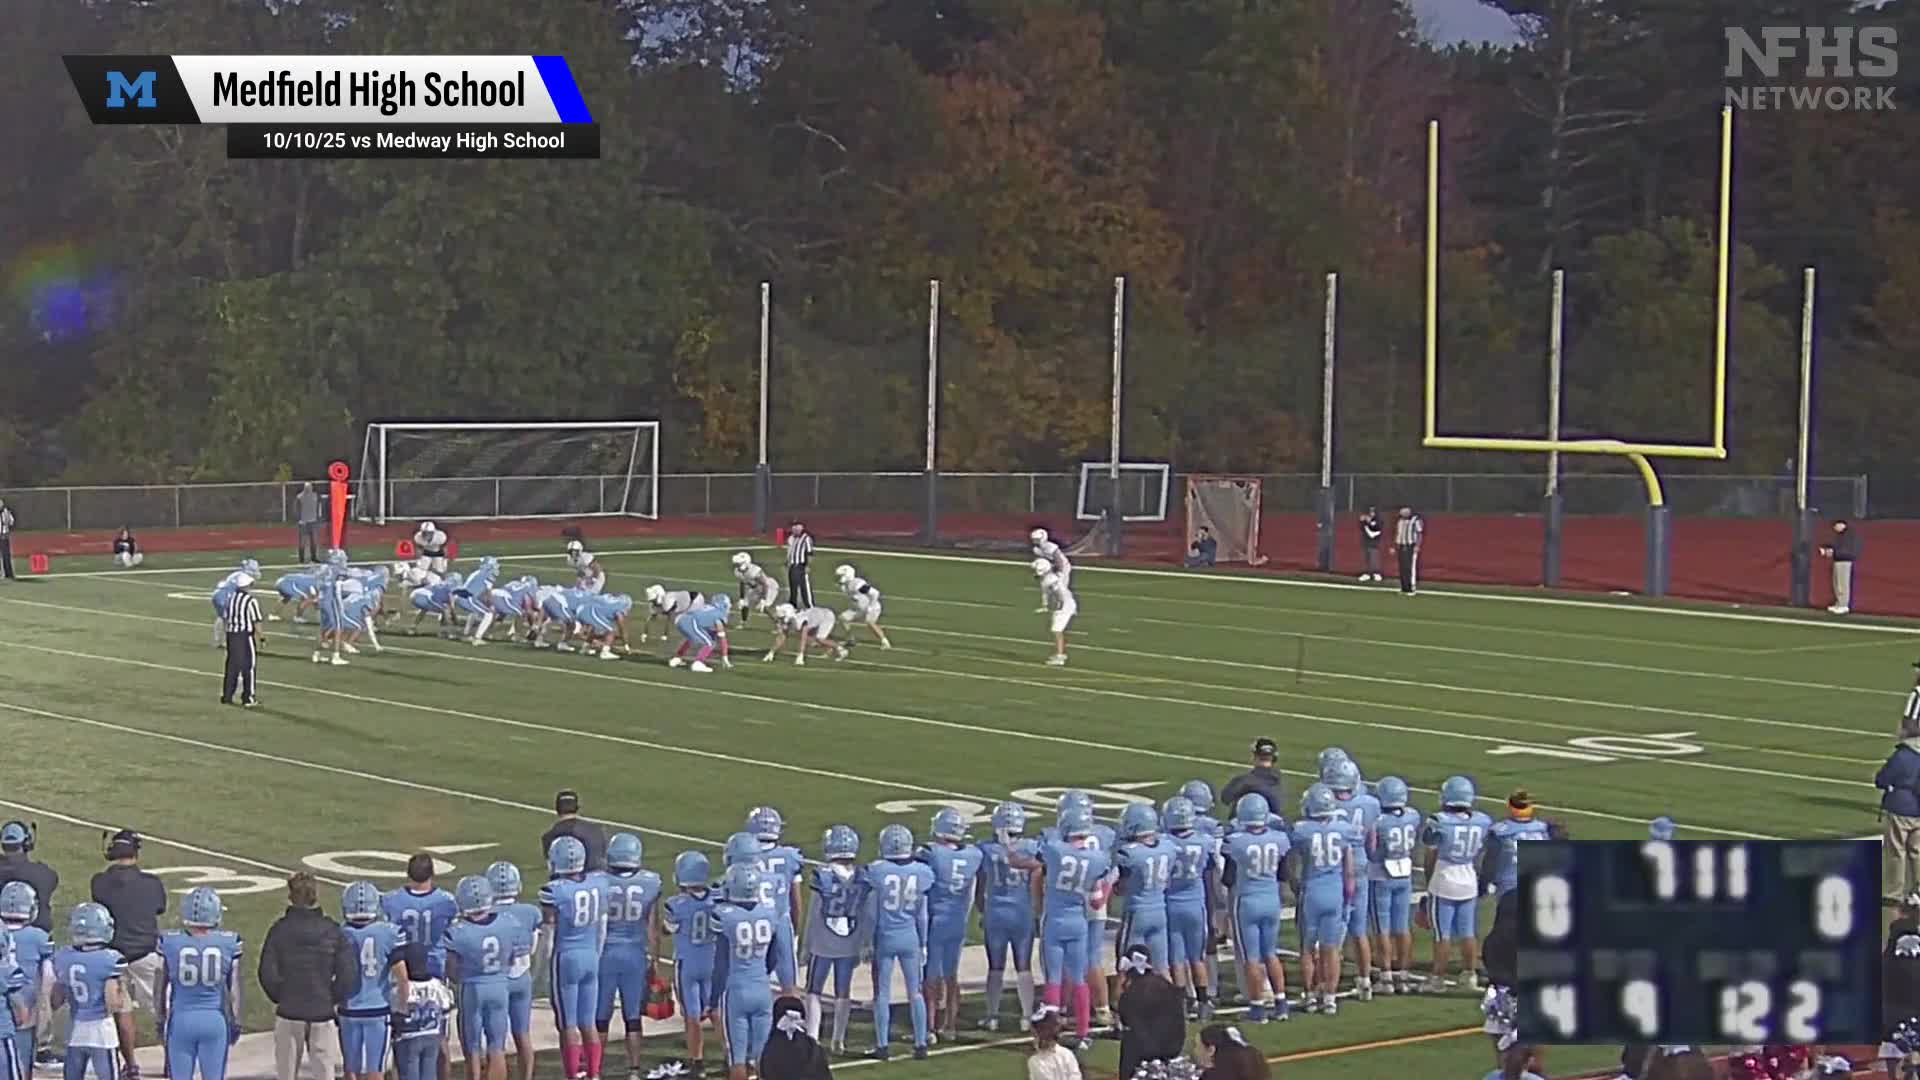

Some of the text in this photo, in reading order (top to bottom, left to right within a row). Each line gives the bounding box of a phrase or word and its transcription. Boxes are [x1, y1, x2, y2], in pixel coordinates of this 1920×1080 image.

[1485, 735, 1704, 763] 10
[1247, 842, 1279, 878] 30
[1311, 831, 1343, 868] 46
[1452, 825, 1483, 858] 50
[883, 873, 919, 912] 34
[1056, 855, 1090, 896] 21
[574, 887, 600, 928] 81
[360, 936, 378, 977] 4
[482, 935, 501, 974] 2
[735, 918, 772, 960] 89
[68, 963, 90, 1003] 6
[178, 945, 223, 988] 60
